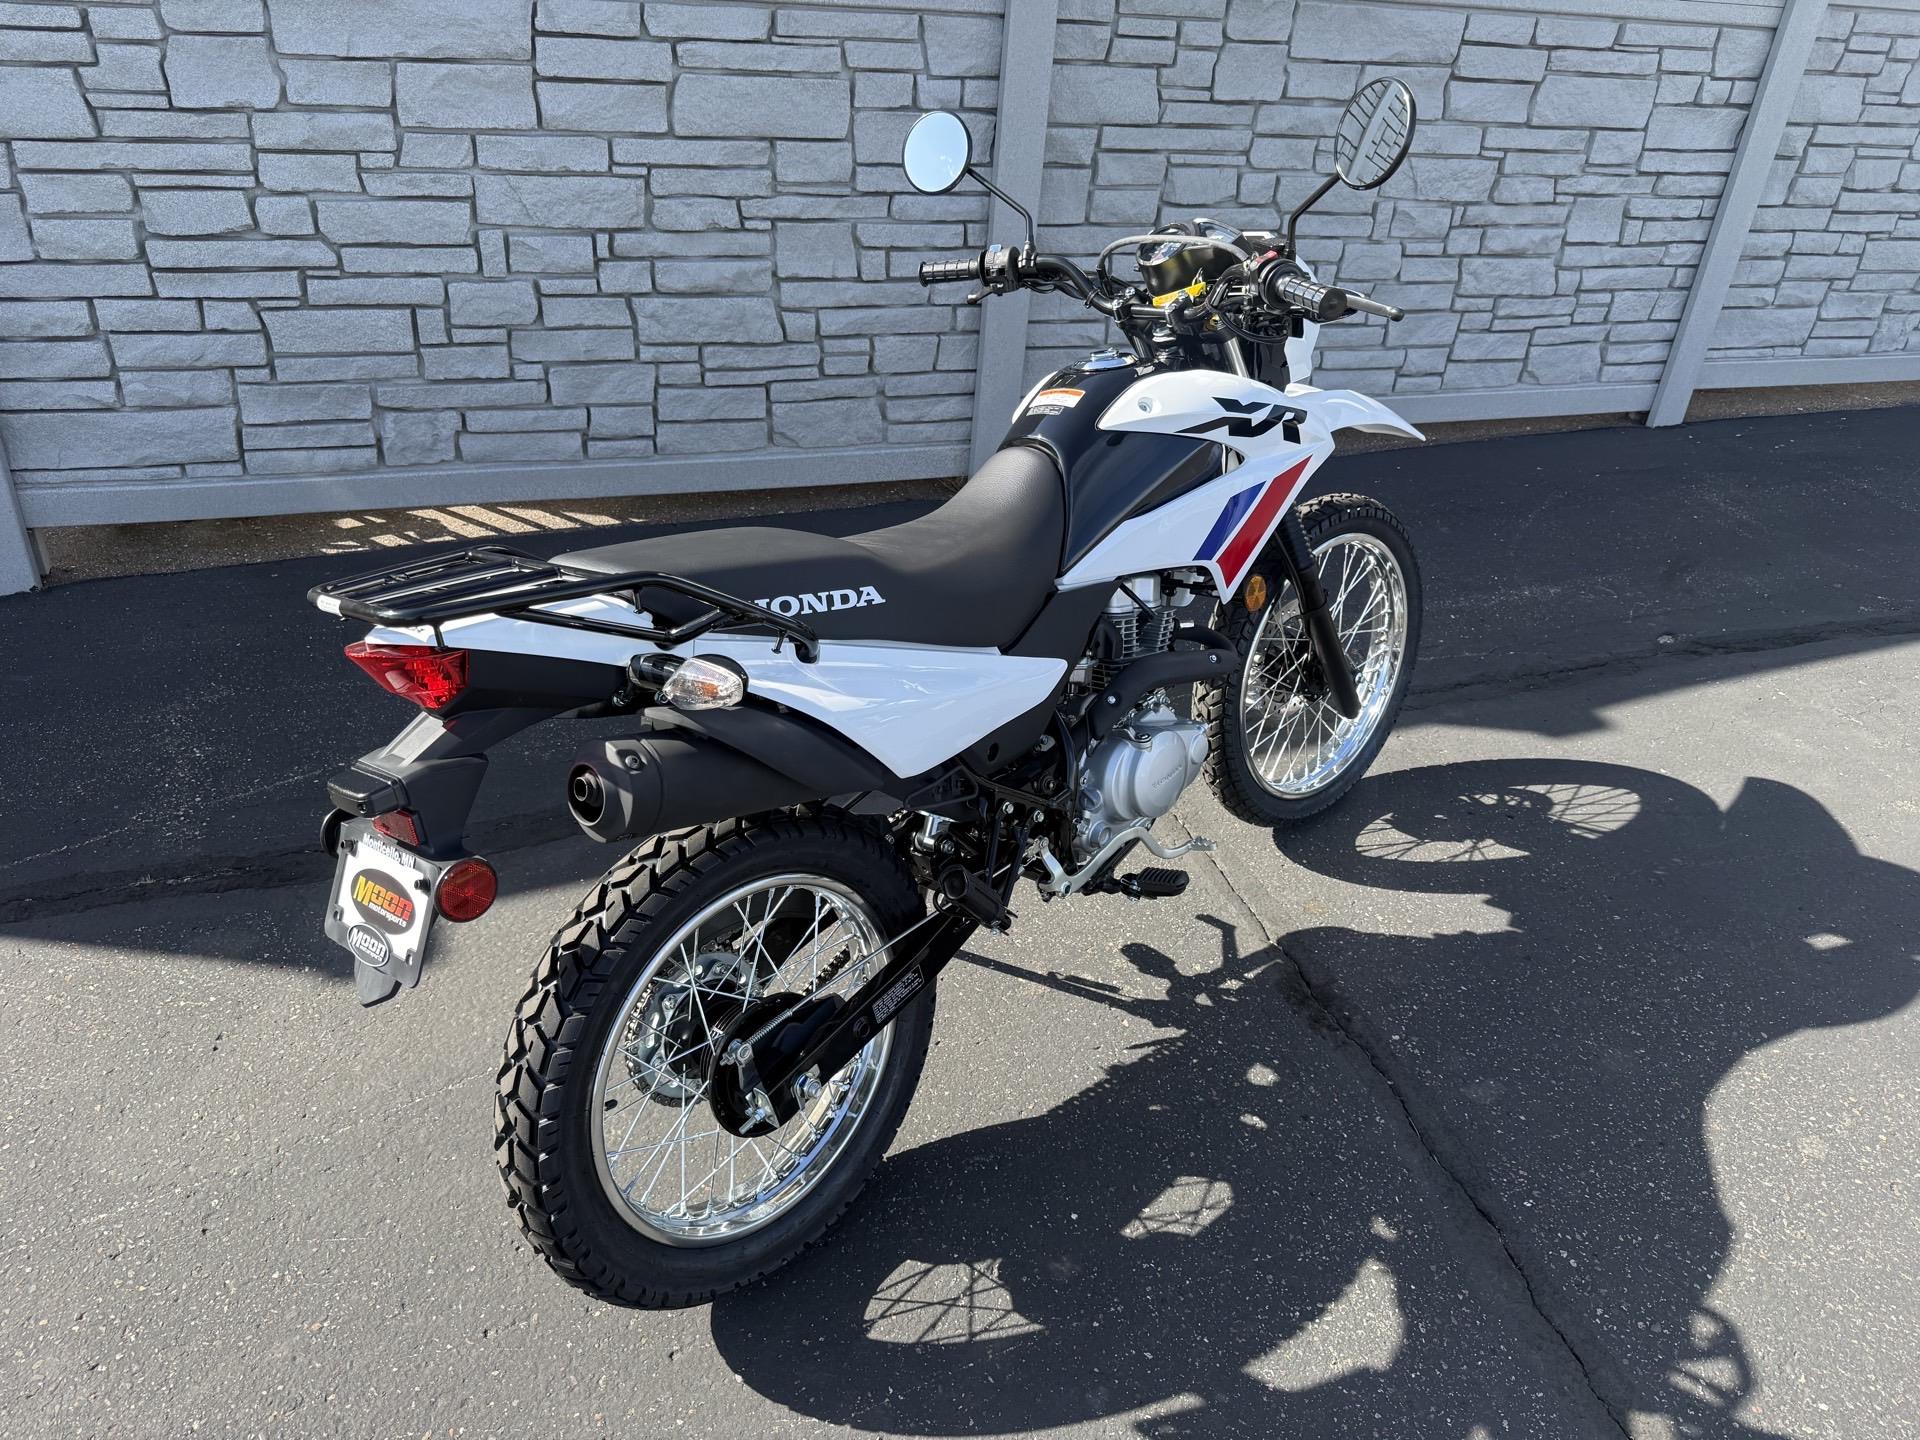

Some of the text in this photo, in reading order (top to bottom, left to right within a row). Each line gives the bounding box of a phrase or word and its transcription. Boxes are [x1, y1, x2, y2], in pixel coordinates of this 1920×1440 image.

[363, 832, 416, 869] Monticello, MN
[368, 901, 407, 928] motorsports
